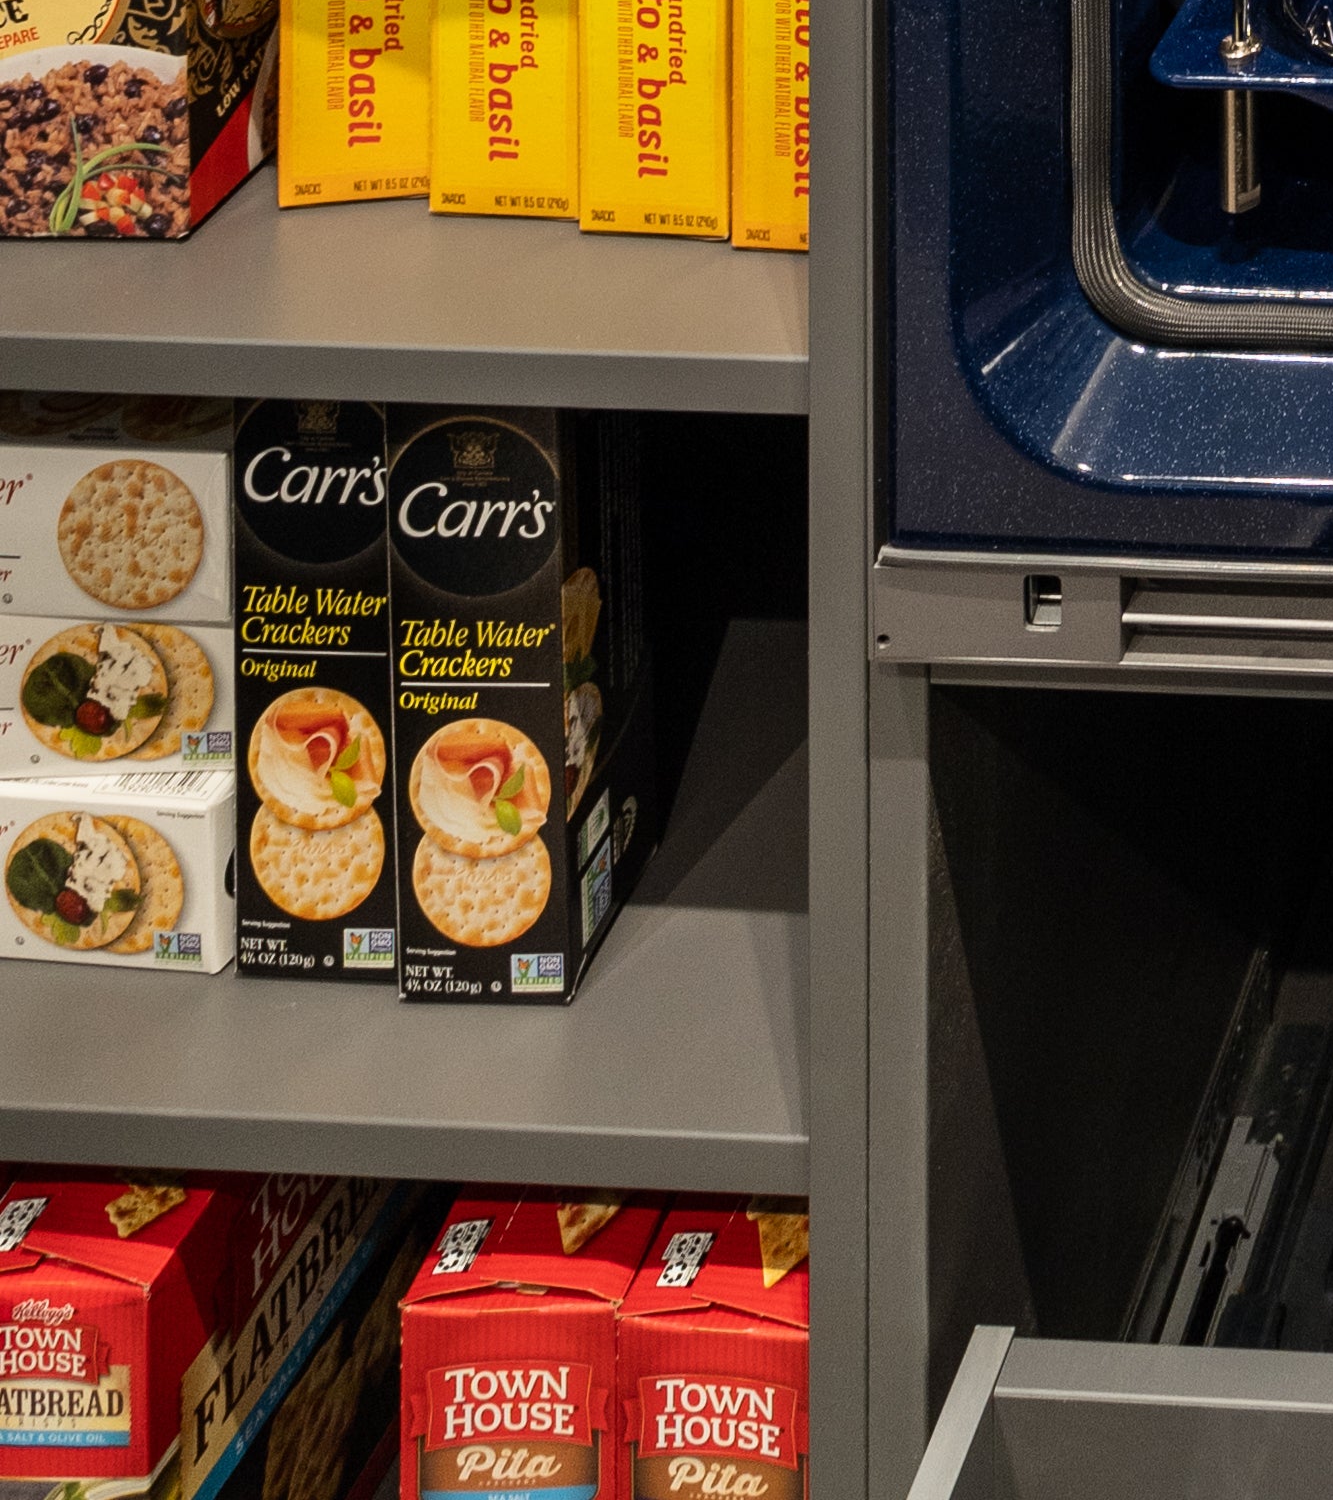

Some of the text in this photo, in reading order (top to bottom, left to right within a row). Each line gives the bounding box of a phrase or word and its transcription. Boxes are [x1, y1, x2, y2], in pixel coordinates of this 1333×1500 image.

[349, 15, 373, 34] &
[348, 49, 382, 148] basil
[244, 446, 386, 505] Carr's
[398, 482, 553, 539] Carr's
[242, 586, 386, 616] Table Water
[241, 616, 350, 645] Crackers
[241, 659, 317, 682] Original
[400, 692, 478, 714] Original
[444, 1367, 570, 1404] TOWN
[444, 1402, 574, 1440] HOUSE
[456, 1445, 561, 1482] Pita
